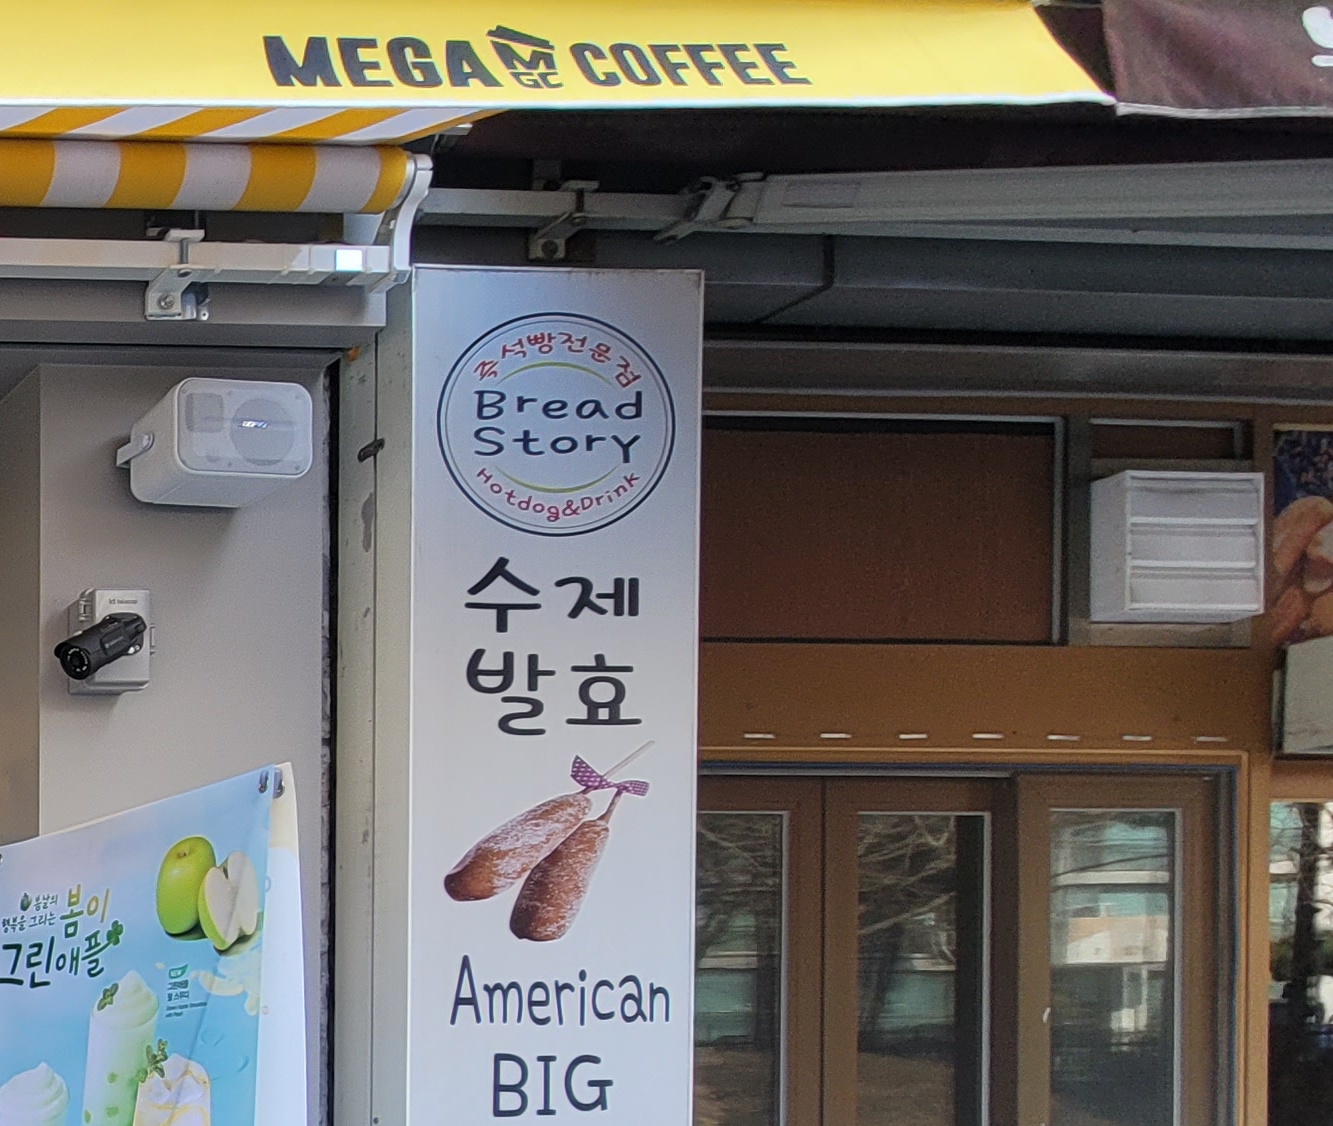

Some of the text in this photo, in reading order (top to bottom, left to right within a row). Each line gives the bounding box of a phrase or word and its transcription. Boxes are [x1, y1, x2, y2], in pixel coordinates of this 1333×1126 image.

[262, 36, 813, 88] MEGA COFFEE
[473, 389, 642, 420] Bread
[464, 556, 639, 633] 수제
[466, 648, 642, 736] 발효
[59, 884, 110, 939] 봄이
[450, 954, 670, 1026] American
[492, 1053, 614, 1117] BIG
